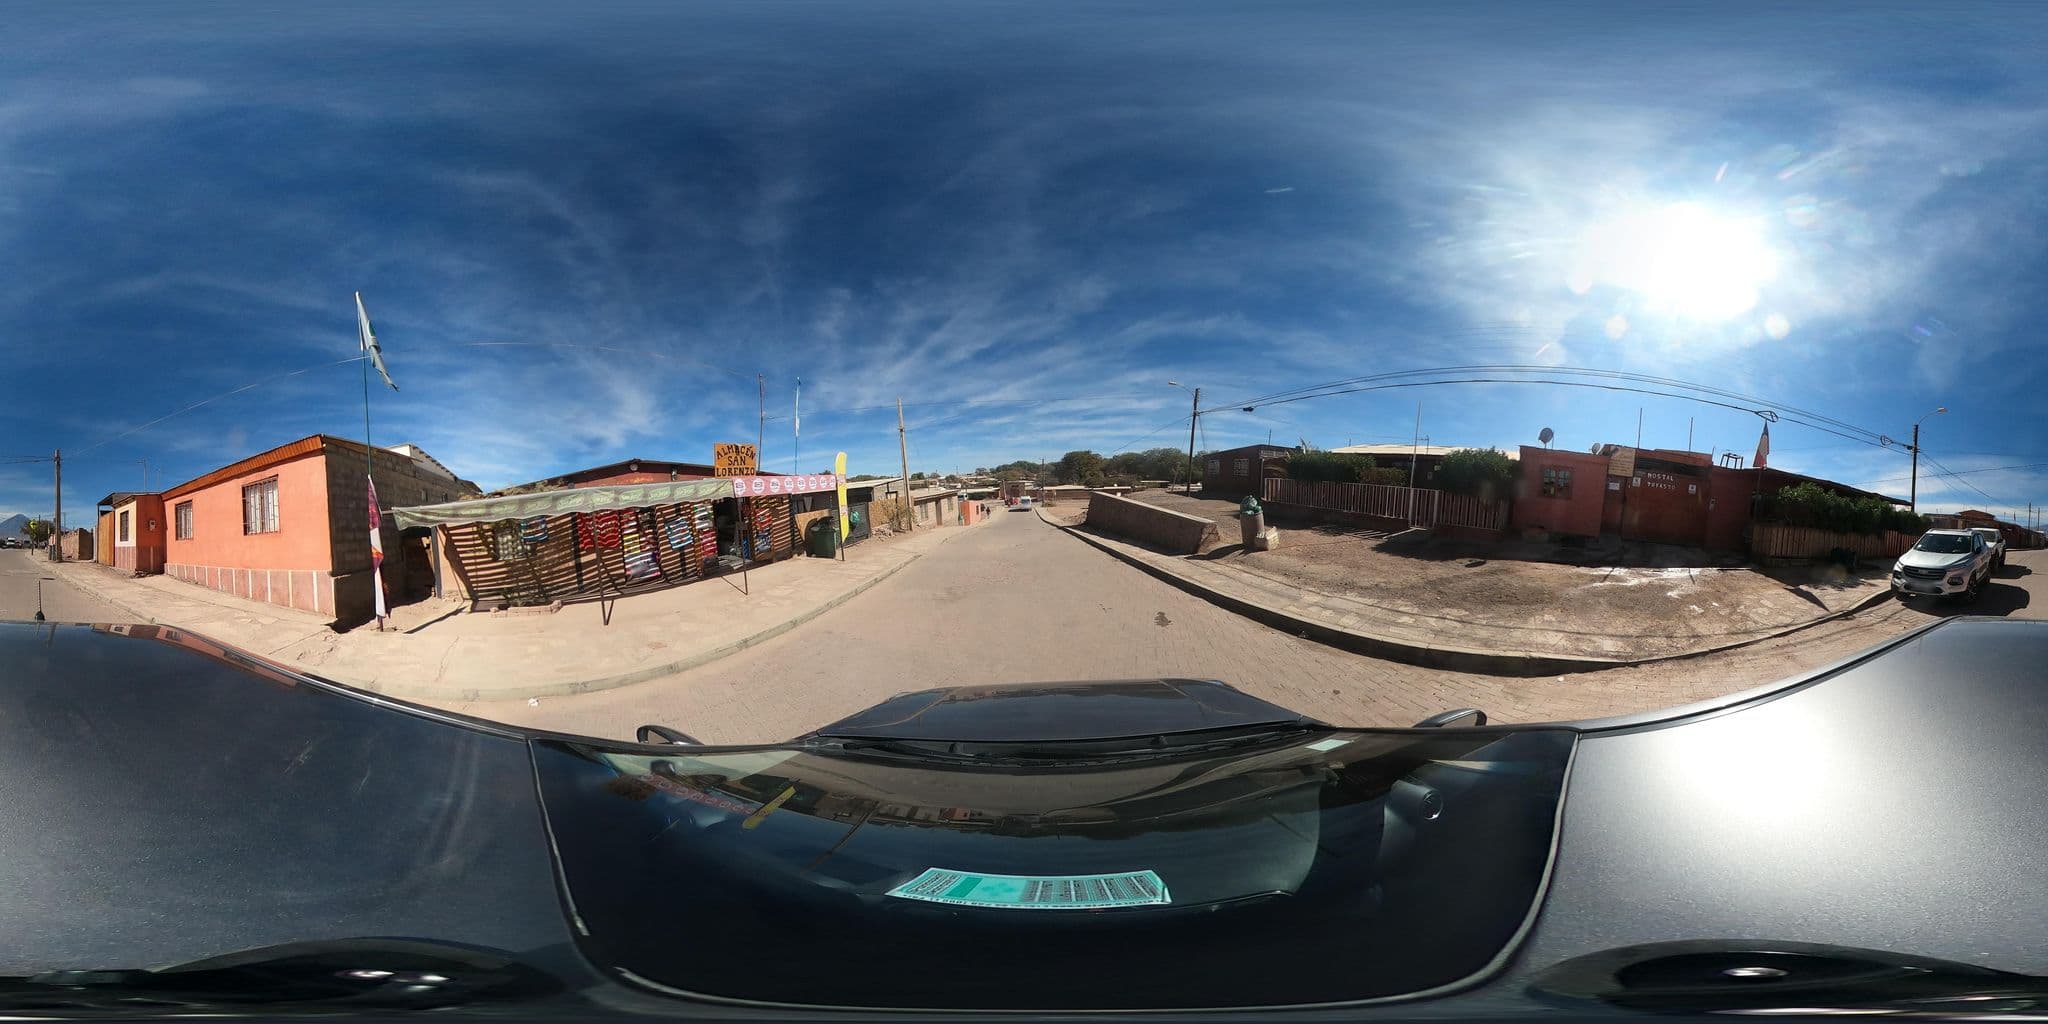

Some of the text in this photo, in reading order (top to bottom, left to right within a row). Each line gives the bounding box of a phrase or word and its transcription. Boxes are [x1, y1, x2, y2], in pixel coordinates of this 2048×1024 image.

[728, 455, 746, 466] SAN
[717, 467, 755, 477] LORENZO
[1647, 472, 1674, 481] HOSTAL
